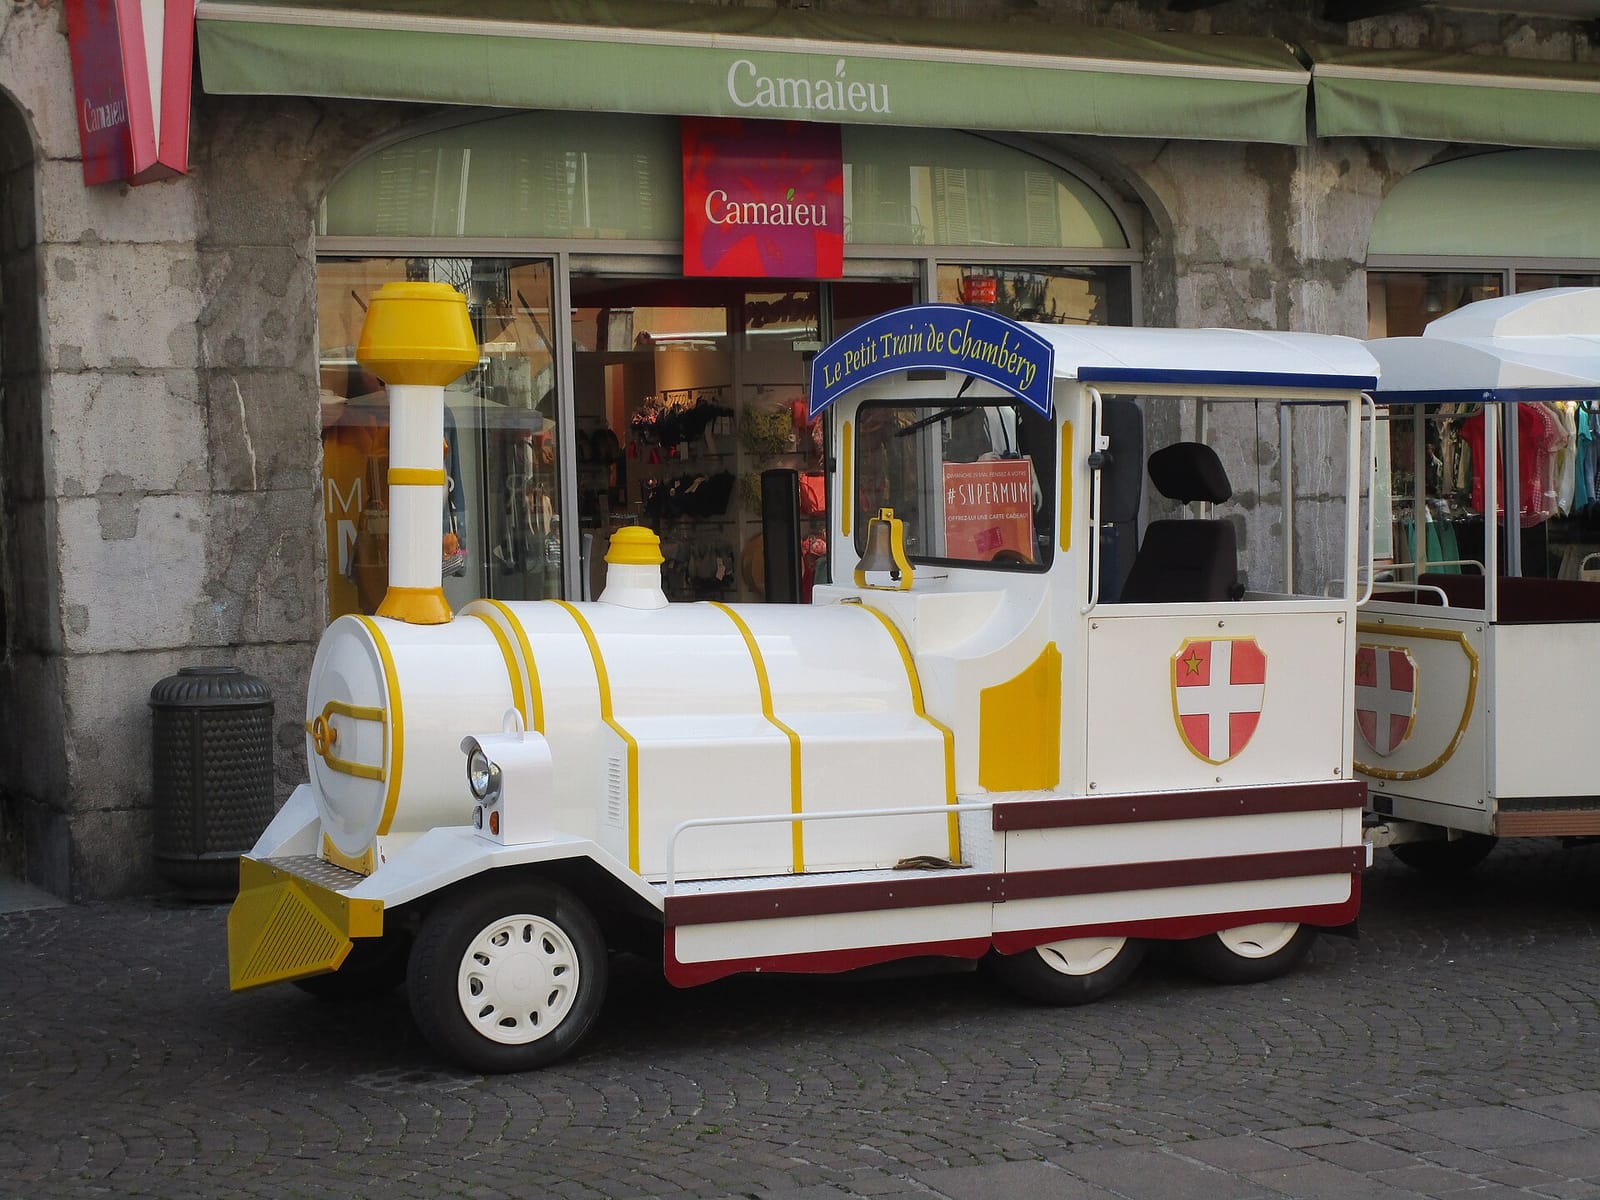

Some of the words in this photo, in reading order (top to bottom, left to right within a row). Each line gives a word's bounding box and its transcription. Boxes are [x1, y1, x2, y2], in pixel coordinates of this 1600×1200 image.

[822, 364, 843, 390] Le
[843, 338, 878, 376] Petit
[879, 324, 923, 359] Train
[926, 322, 944, 352] de
[947, 319, 1038, 391] Chambéry
